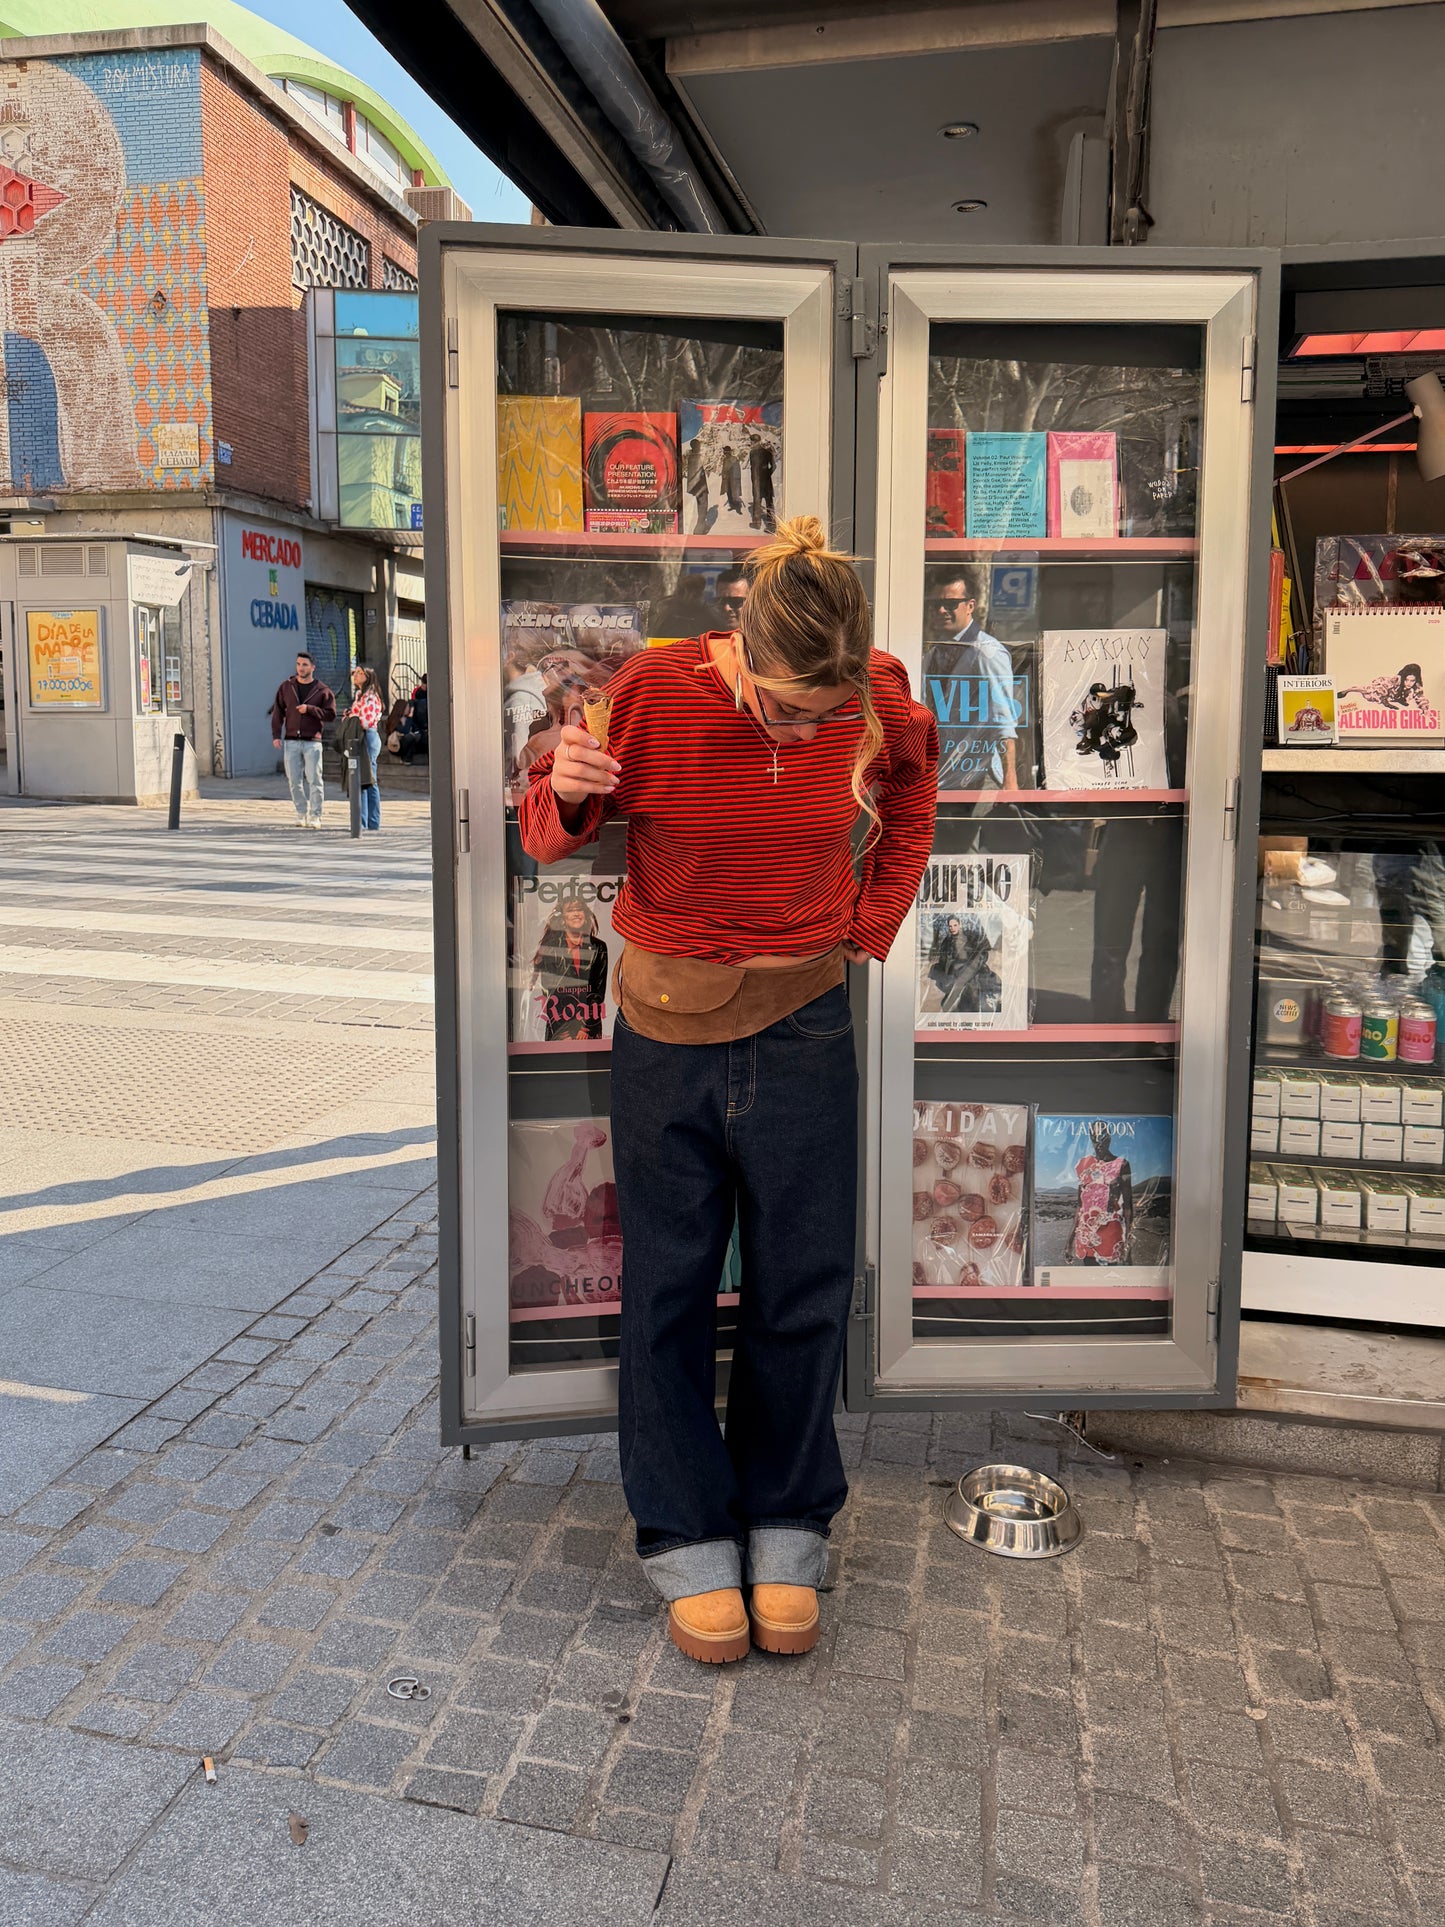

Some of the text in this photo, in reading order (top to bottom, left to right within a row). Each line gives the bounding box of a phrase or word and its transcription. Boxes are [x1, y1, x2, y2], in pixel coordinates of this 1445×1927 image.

[160, 457, 198, 466] CEBADA
[242, 529, 301, 569] MERCADO
[269, 569, 277, 582] DE
[269, 582, 278, 596] LA
[250, 599, 299, 631] CEBADA
[69, 623, 81, 634] DE
[82, 628, 94, 638] LA
[1283, 679, 1333, 687] INTERIORS
[929, 679, 1022, 722] VHS
[505, 704, 531, 716] TYRA
[512, 709, 547, 723] BANKS
[1338, 710, 1397, 729] ALENDAR
[1400, 710, 1437, 729] GIRLS
[944, 740, 1008, 754] POEMS
[949, 757, 988, 772] VOL.
[557, 985, 592, 995] Chappell
[534, 995, 607, 1023] Roan
[1071, 1121, 1135, 1137] LAMPOON
